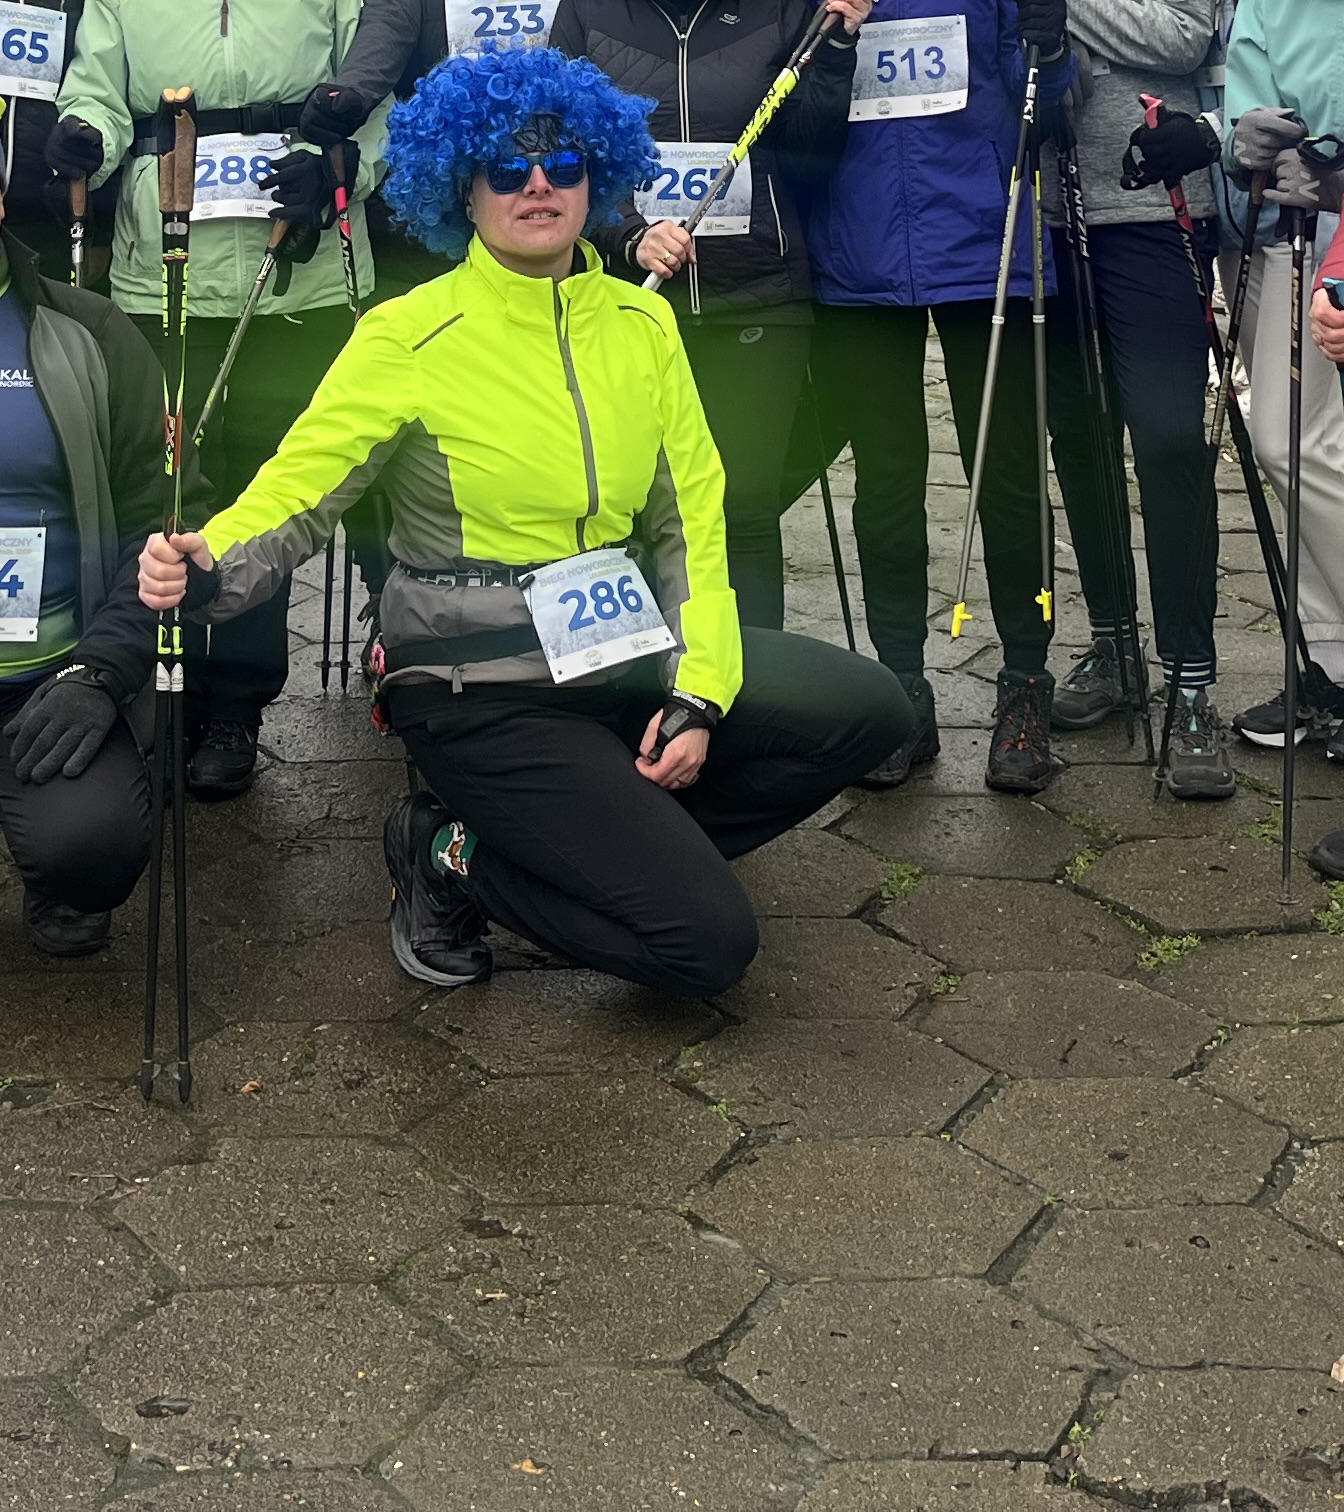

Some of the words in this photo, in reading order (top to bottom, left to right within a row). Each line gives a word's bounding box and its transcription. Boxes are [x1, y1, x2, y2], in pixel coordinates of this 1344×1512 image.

[470, 3, 545, 38] 233
[875, 45, 947, 84] 513
[195, 155, 274, 188] 288
[655, 167, 734, 201] 267
[1072, 187, 1091, 258] FIZAN
[557, 574, 644, 633] 286
